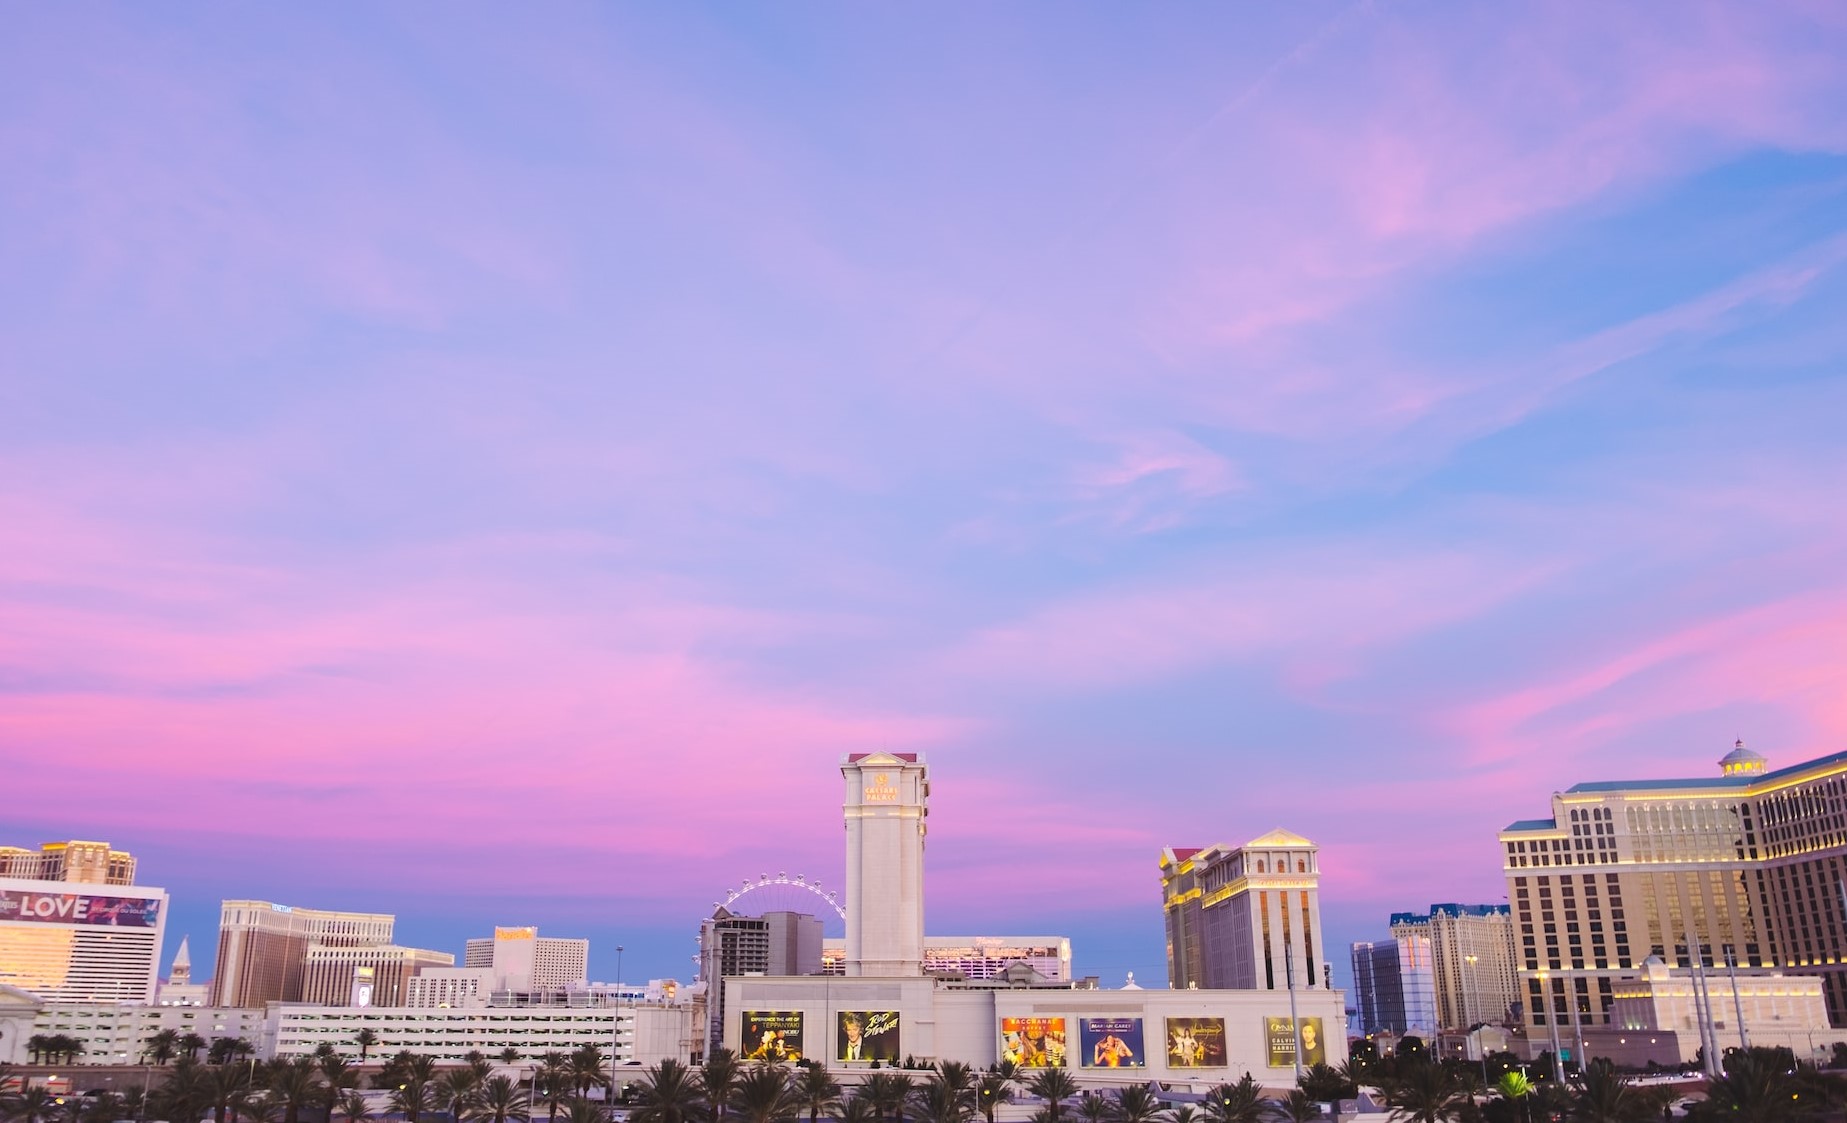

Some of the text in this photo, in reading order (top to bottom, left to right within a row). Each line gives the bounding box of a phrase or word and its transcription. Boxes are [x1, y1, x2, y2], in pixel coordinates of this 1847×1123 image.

[20, 896, 90, 919] LOVE
[864, 1018, 899, 1038] STEWART
[868, 1013, 890, 1028] ROD
